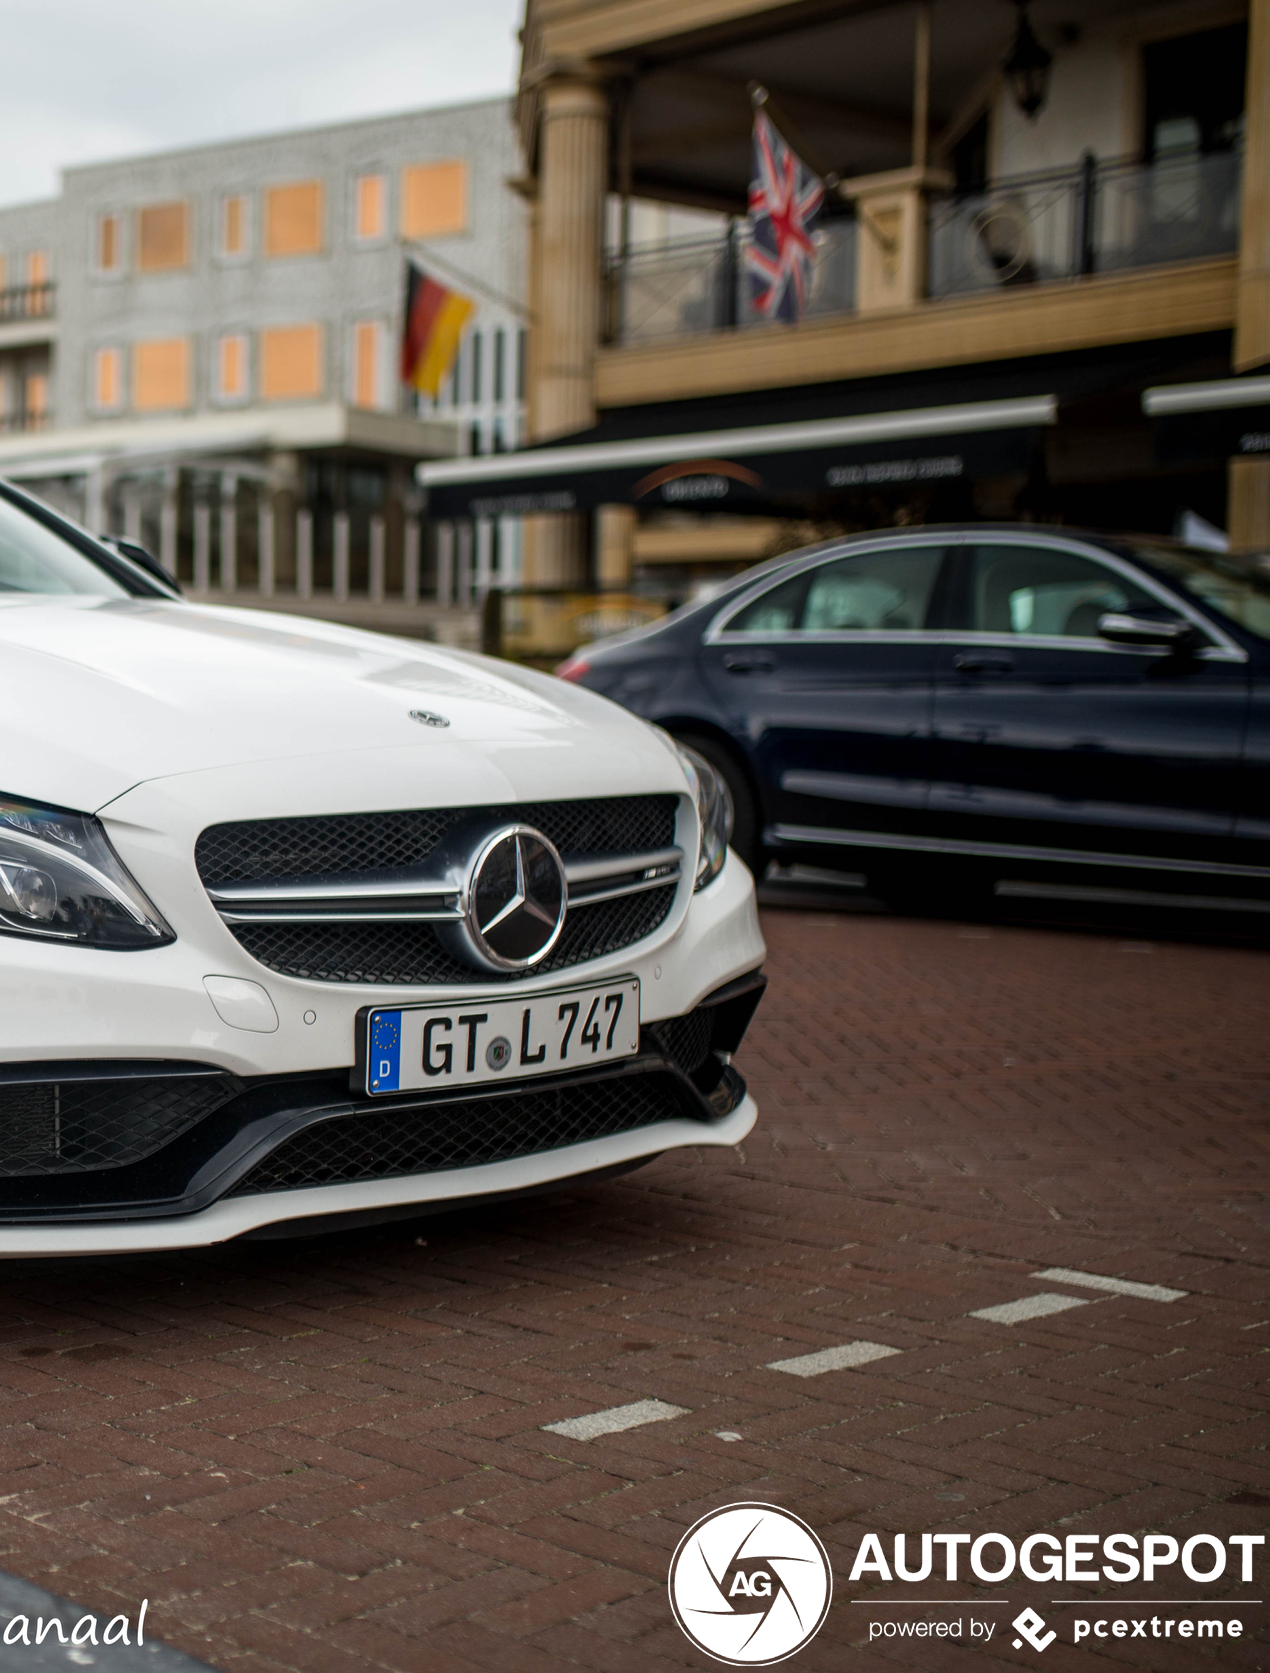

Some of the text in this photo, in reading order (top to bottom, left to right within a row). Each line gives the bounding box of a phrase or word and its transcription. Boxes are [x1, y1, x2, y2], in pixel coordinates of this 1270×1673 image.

[422, 1012, 488, 1076] GT
[519, 1008, 546, 1066] L
[558, 992, 624, 1060] 747
[379, 1060, 391, 1078] D
